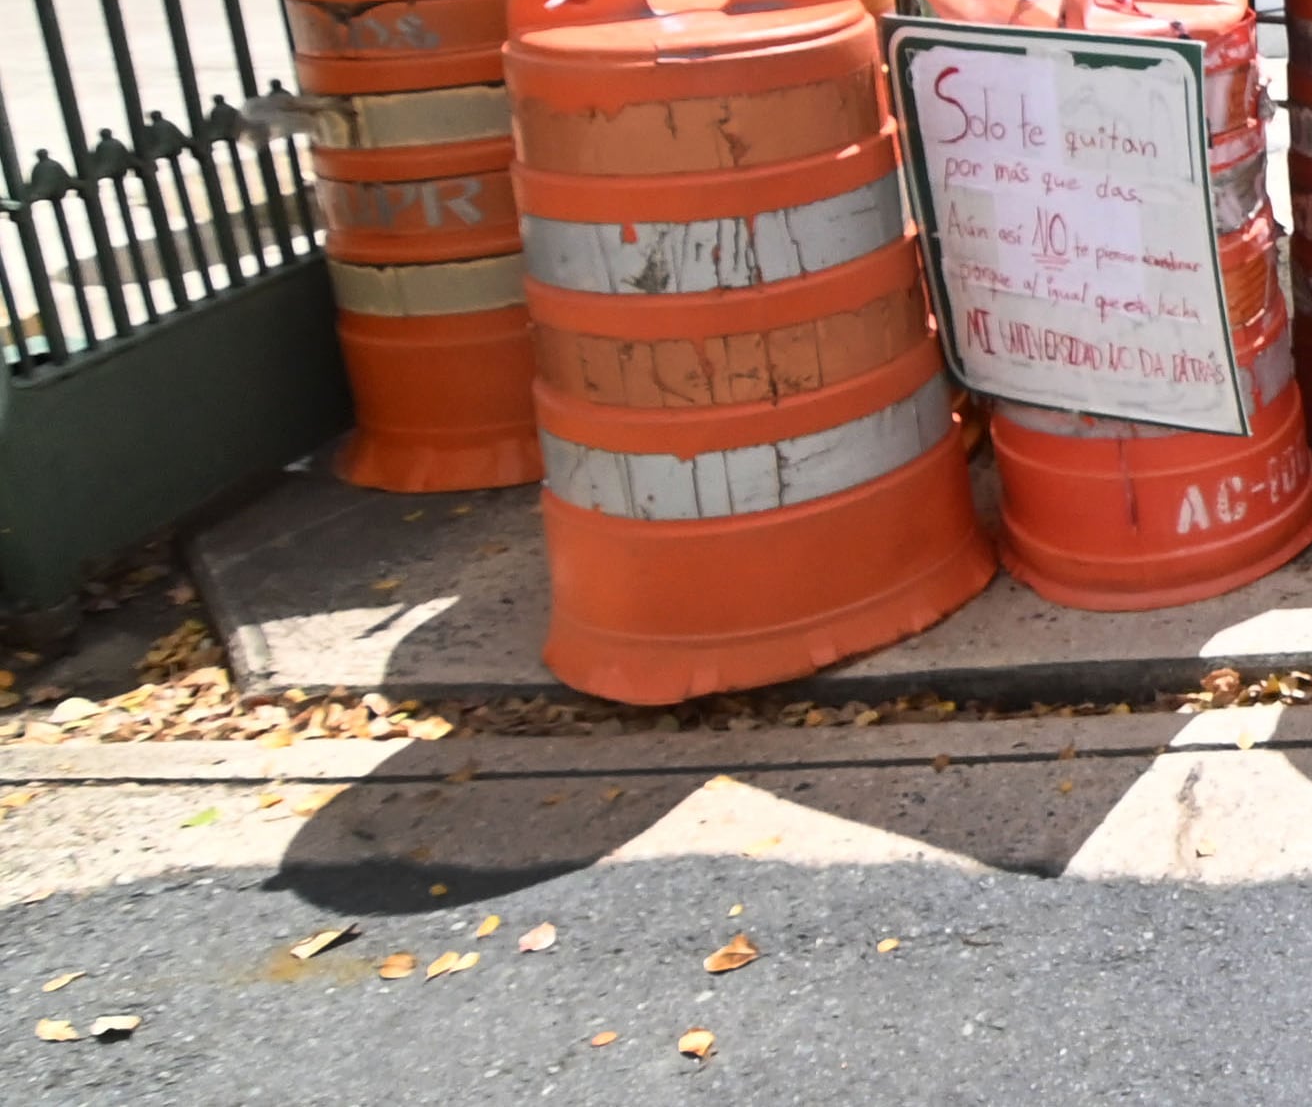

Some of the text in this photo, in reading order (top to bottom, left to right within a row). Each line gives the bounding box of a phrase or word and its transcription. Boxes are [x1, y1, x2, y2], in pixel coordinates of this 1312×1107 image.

[936, 66, 1158, 159] Solo te quitan
[943, 157, 983, 193] por
[993, 162, 1030, 184] más
[1042, 172, 1083, 197] que
[947, 199, 990, 241] Aún
[1031, 204, 1068, 257] NO
[1074, 232, 1089, 259] te
[965, 305, 996, 356] MI
[998, 319, 1104, 372] UNIVERSIDAD
[1106, 341, 1136, 372] NO
[1137, 345, 1166, 379] DA
